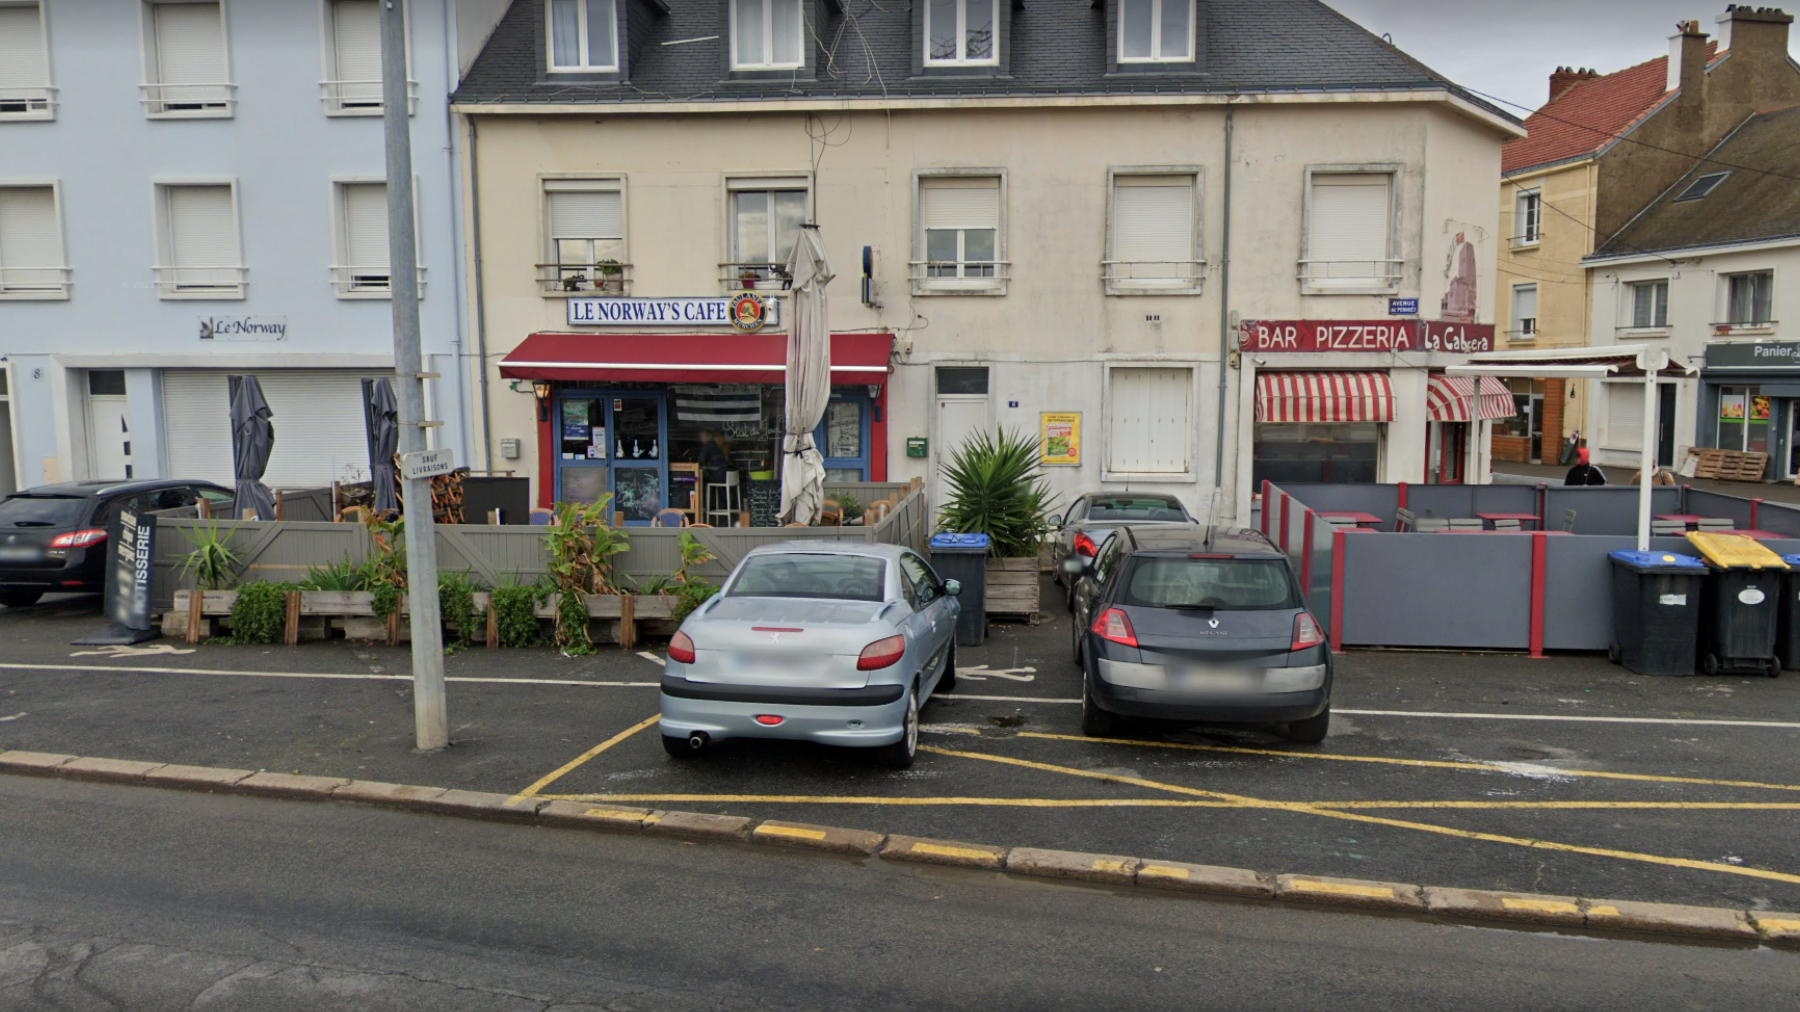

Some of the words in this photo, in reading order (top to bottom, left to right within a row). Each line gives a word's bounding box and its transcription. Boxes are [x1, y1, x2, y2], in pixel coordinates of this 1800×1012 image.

[731, 293, 765, 308] PAULANER
[574, 302, 594, 320] LE
[598, 302, 680, 321] NORWAY'S
[684, 302, 726, 320] CAFE
[214, 320, 231, 334] Le
[233, 316, 286, 341] Norway
[1258, 326, 1297, 348] BAR
[1316, 326, 1410, 348] PIZZERIA
[1424, 323, 1440, 349] La
[1444, 325, 1488, 351] Cabrera
[1754, 345, 1792, 357] Panier
[33, 368, 41, 379] 8
[422, 454, 437, 463] SAUF
[412, 463, 448, 475] LIVRAISONS
